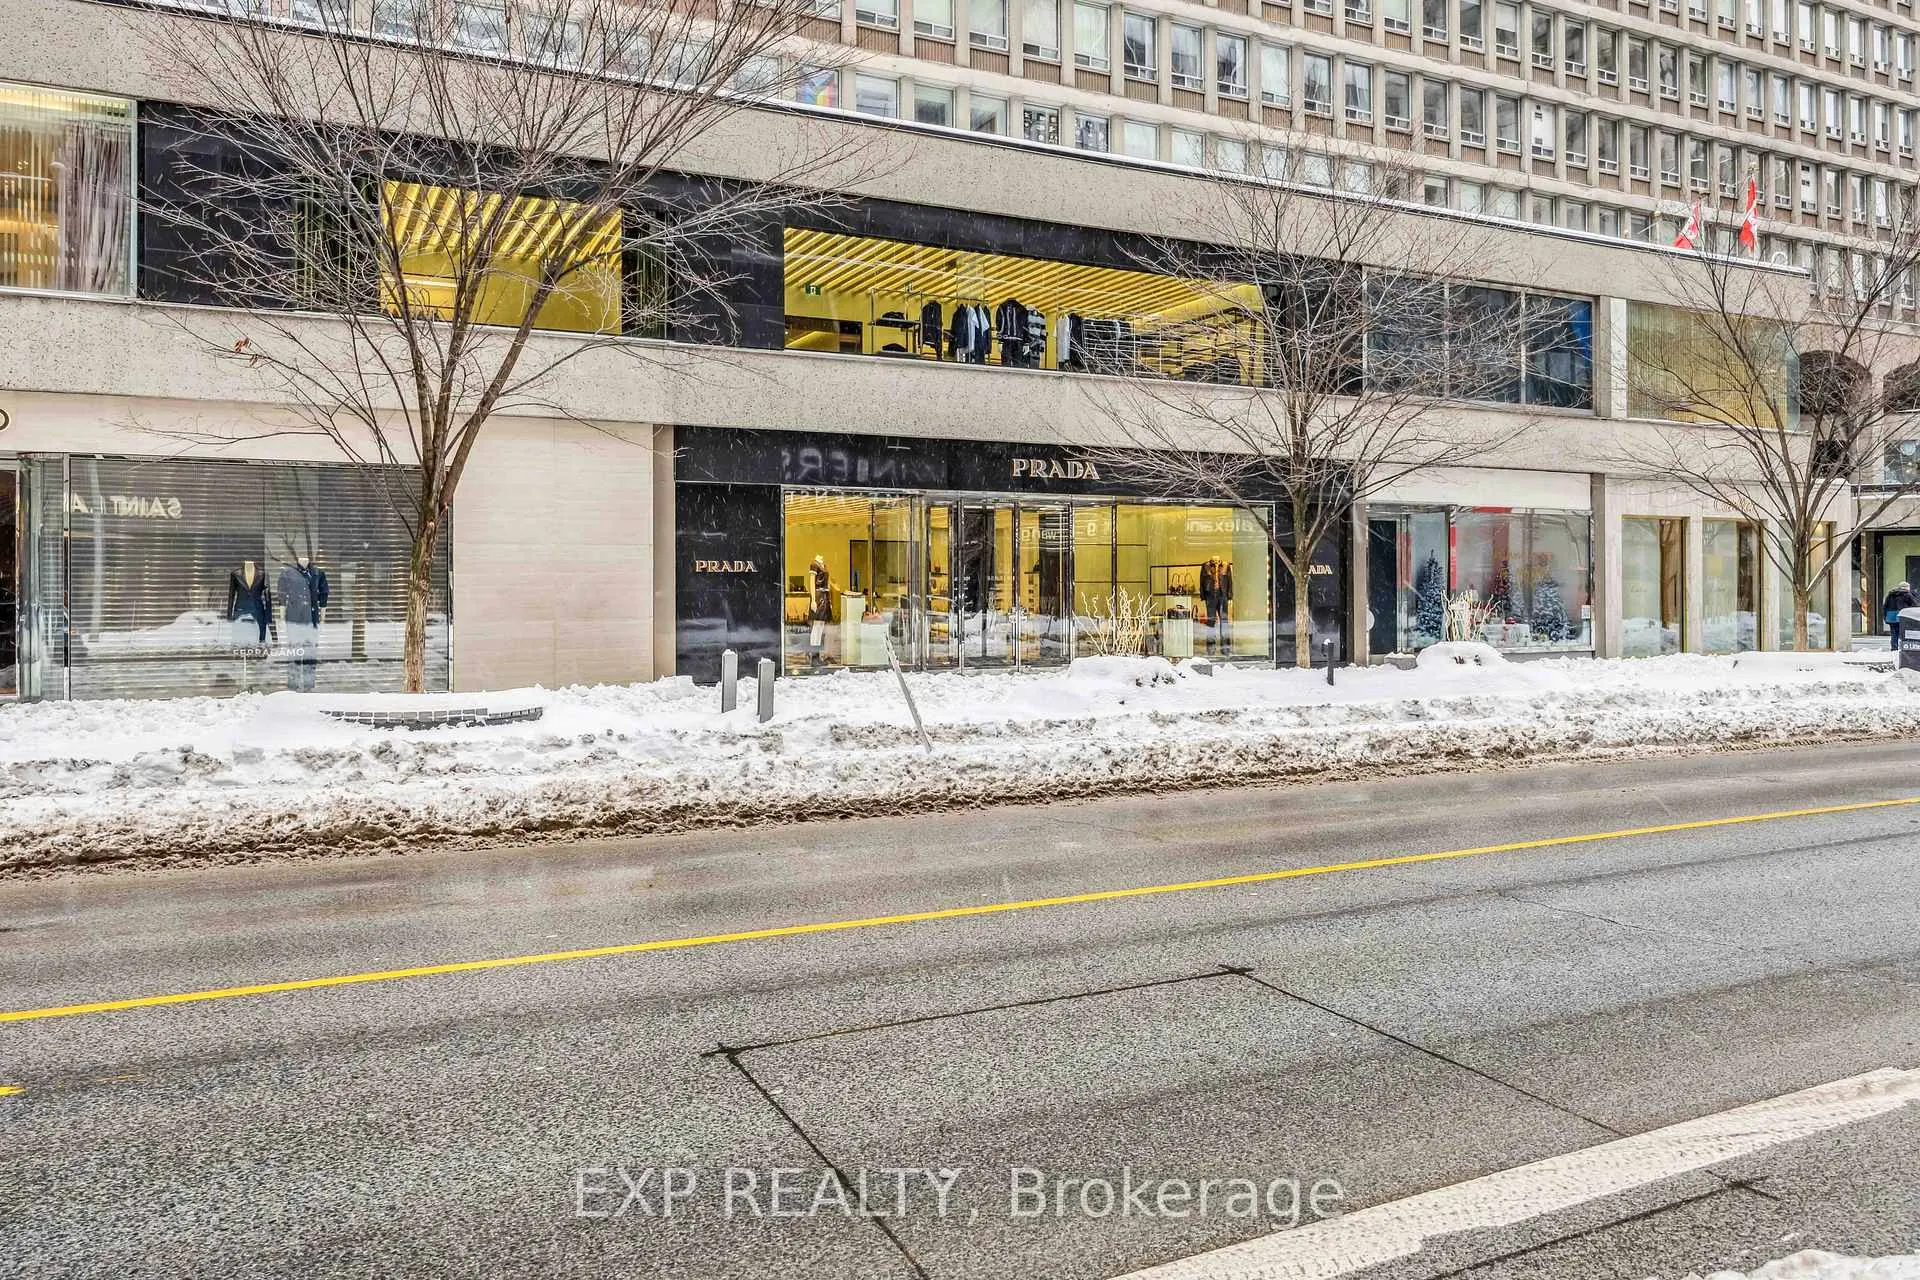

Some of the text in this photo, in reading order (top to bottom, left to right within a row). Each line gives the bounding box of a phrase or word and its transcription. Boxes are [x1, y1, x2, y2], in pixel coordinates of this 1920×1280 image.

[1012, 457, 1100, 480] PRADA
[695, 560, 758, 573] PRADA
[1308, 564, 1333, 575] ADA
